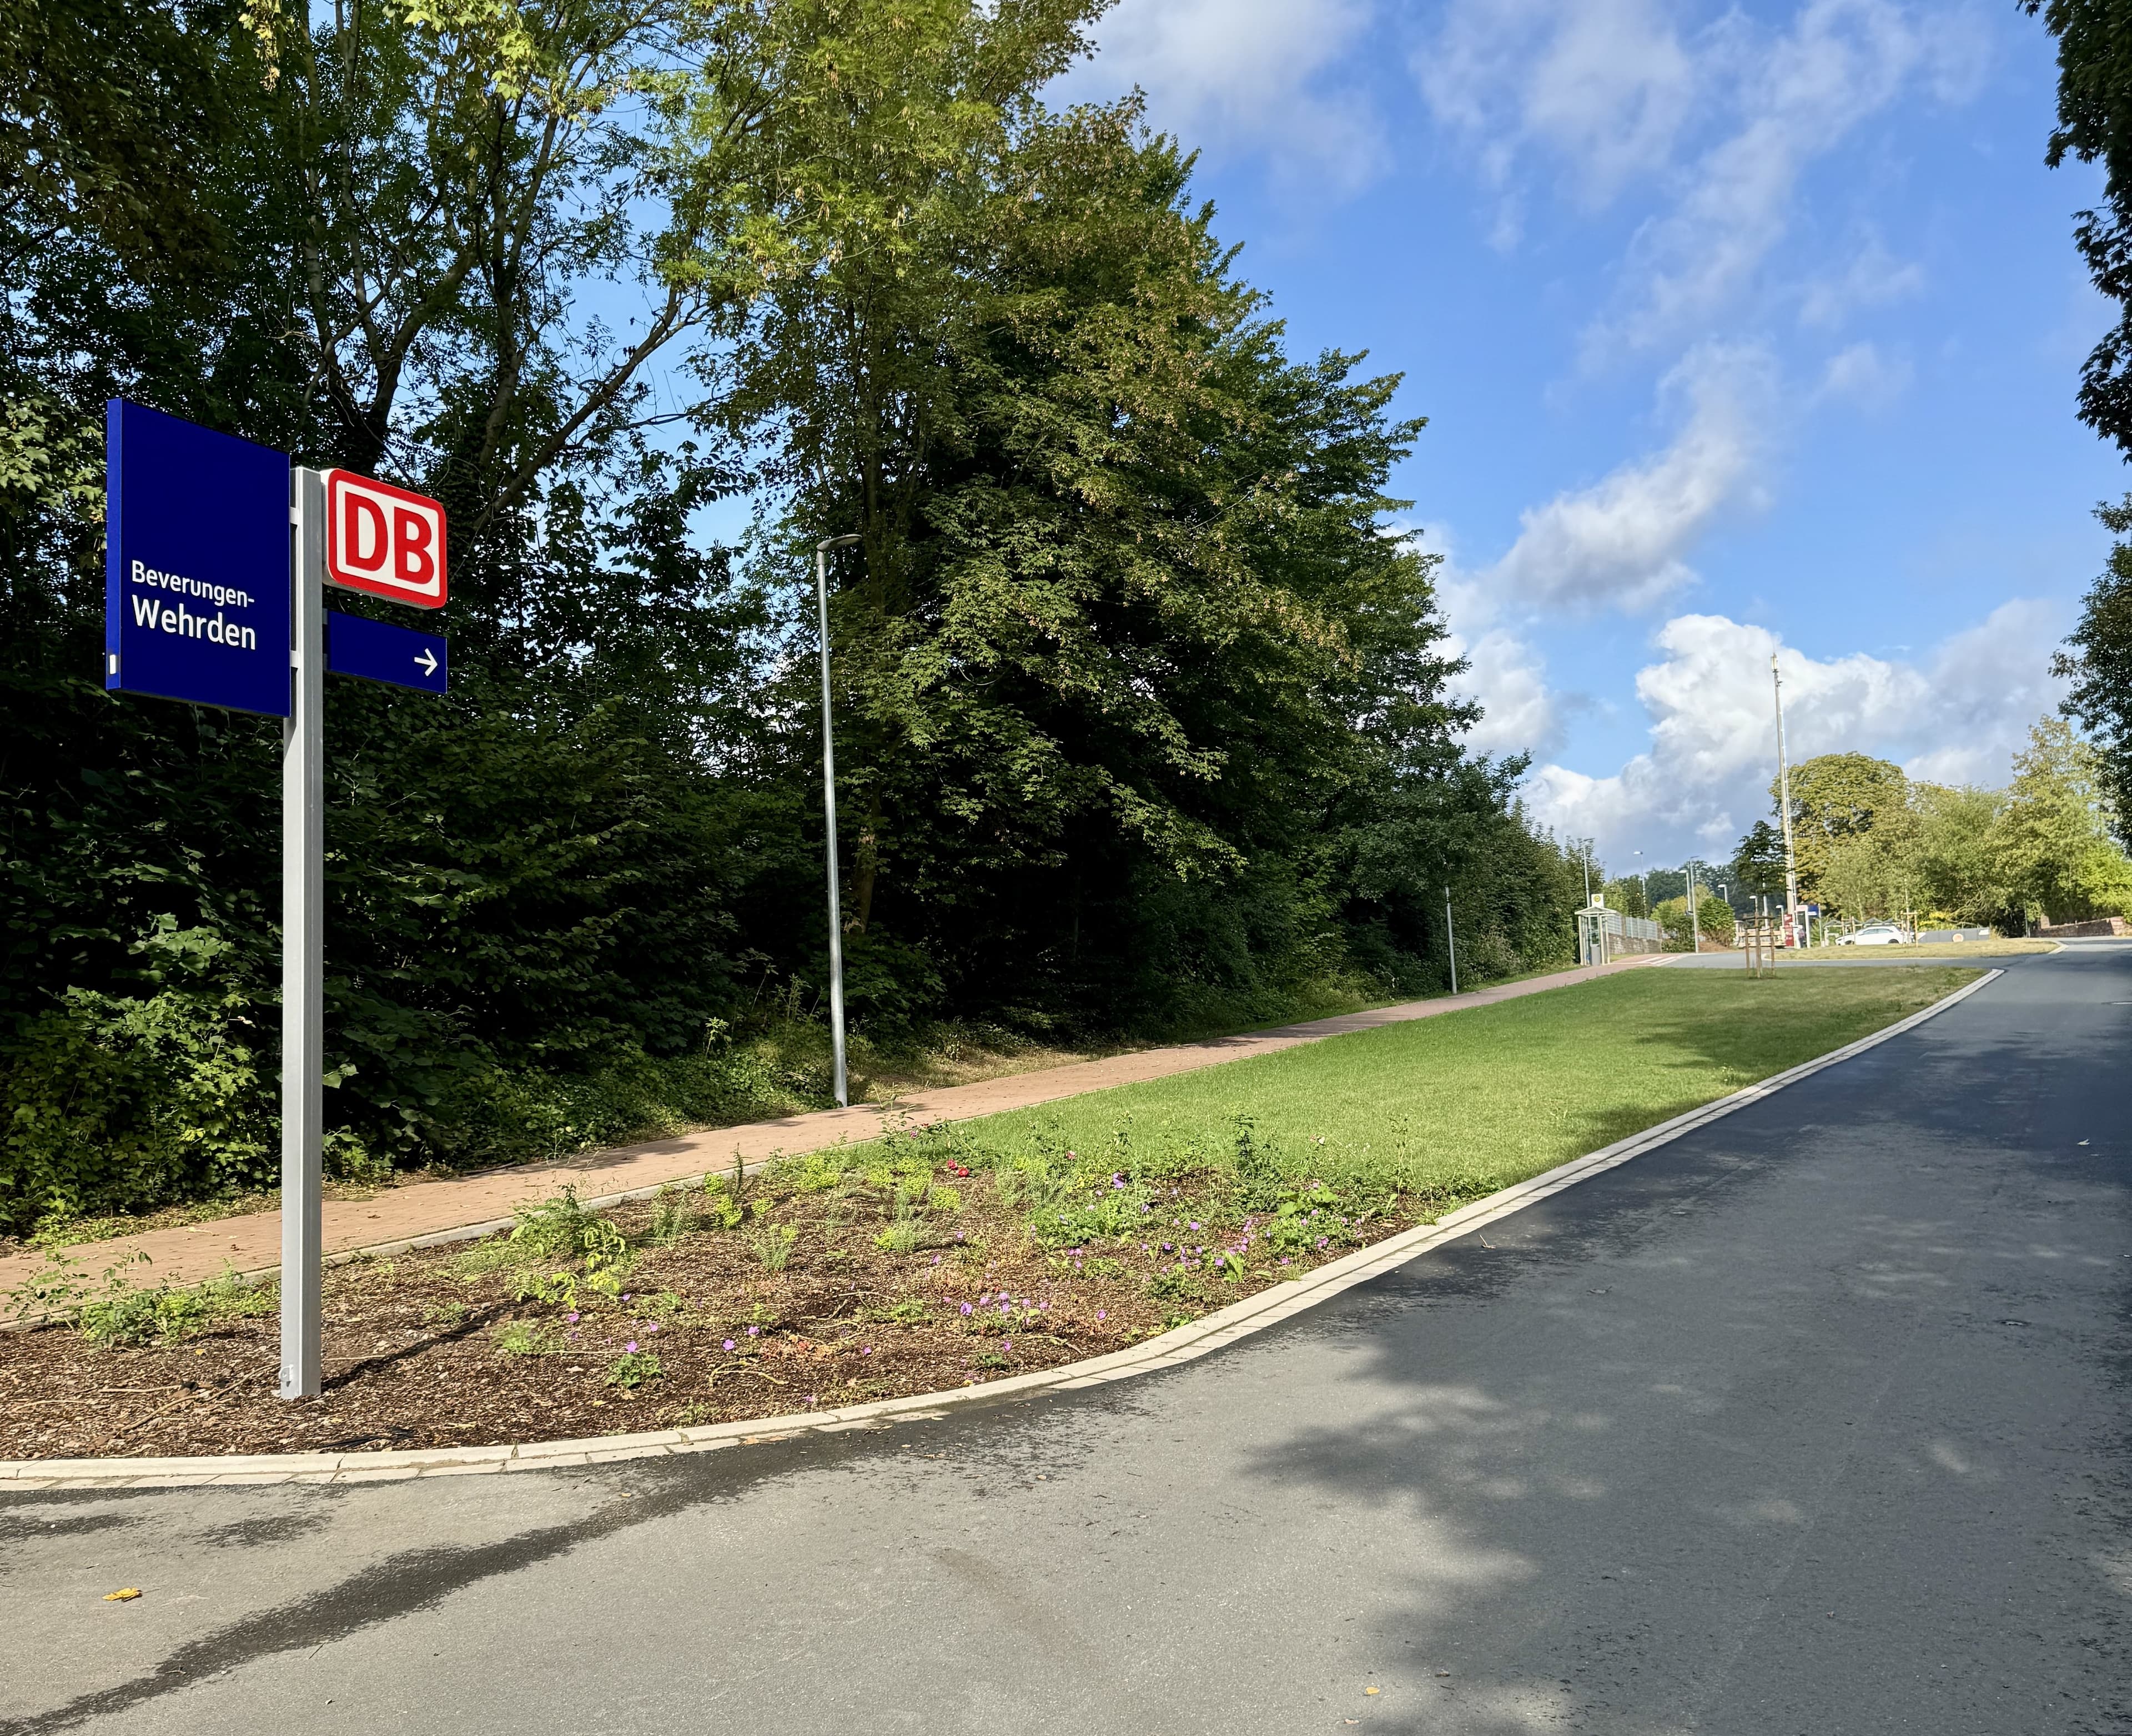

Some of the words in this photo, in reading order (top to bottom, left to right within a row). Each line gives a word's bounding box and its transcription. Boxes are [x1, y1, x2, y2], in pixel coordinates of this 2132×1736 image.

[345, 492, 434, 585] DB
[132, 560, 255, 607] Beverungen-
[132, 594, 255, 650] Wehrden
